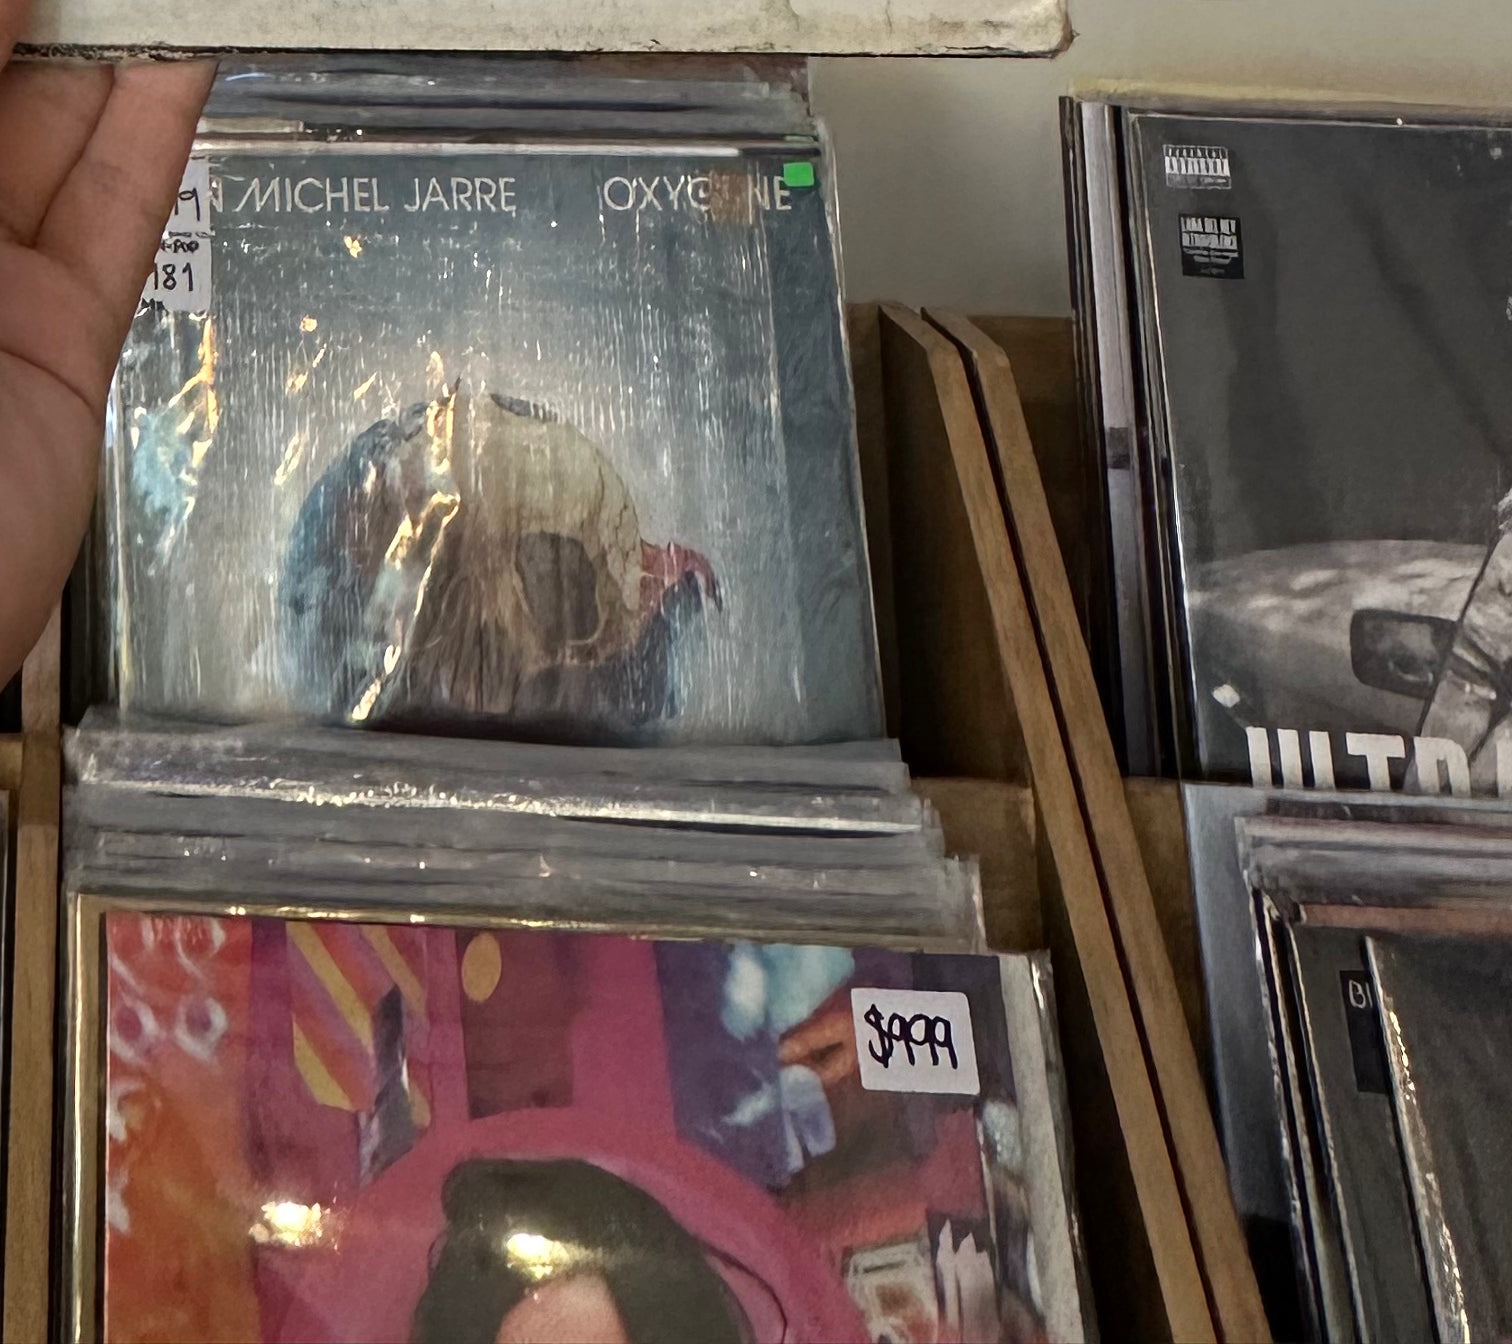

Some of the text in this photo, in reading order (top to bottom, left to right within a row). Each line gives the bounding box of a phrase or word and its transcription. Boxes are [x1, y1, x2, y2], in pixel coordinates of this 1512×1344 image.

[234, 175, 391, 213] MICHEL
[403, 176, 517, 214] JARRE
[603, 174, 793, 212] OXYGNE
[863, 1003, 959, 1070] $999
